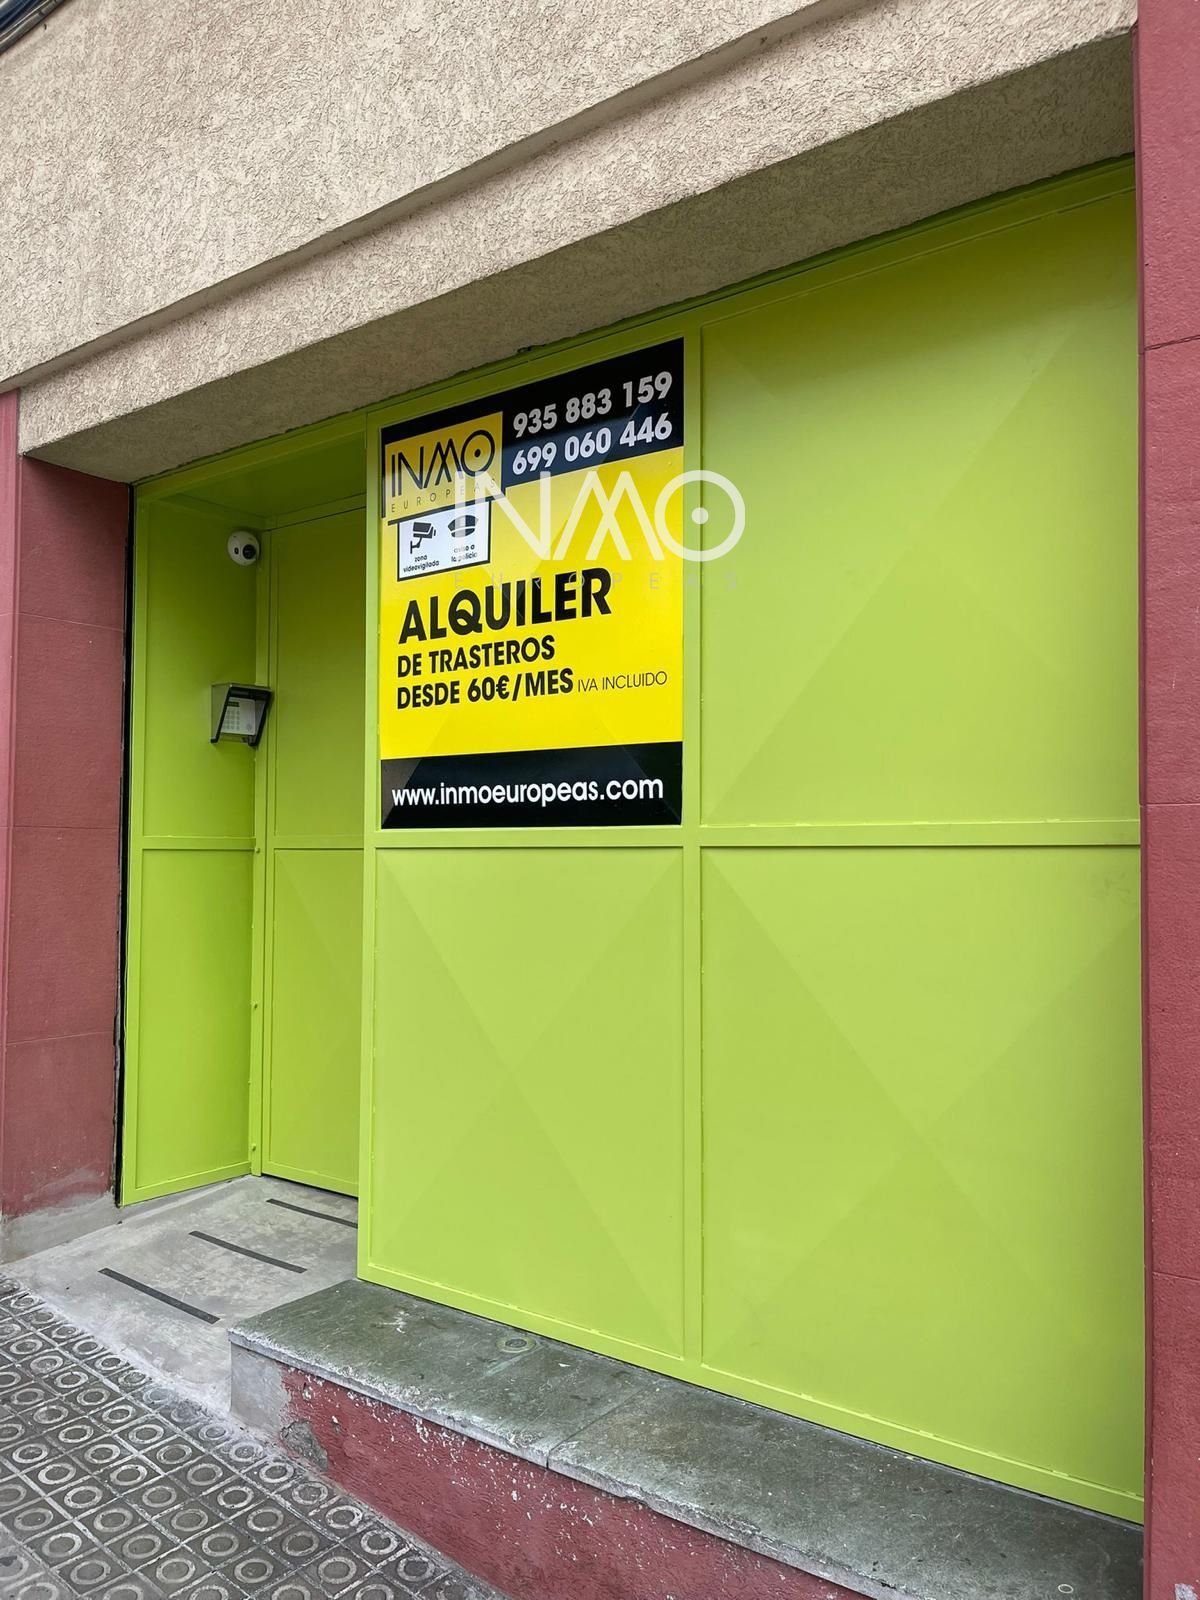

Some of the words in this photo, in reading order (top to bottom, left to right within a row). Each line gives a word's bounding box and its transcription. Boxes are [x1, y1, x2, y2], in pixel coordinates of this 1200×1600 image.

[513, 407, 558, 438] 935
[566, 388, 612, 424] 883
[622, 371, 673, 408] 159
[391, 429, 496, 498] INMO
[512, 442, 557, 475] 699
[564, 427, 612, 462] 060
[620, 412, 673, 448] 446
[403, 560, 440, 573] videovigilada
[414, 554, 428, 563] zona
[398, 567, 612, 645] ALQUILER
[397, 652, 422, 678] DE
[429, 634, 556, 675] TRASTEROS
[397, 682, 460, 710] DESDE
[467, 668, 574, 702] 60€/MES
[578, 677, 599, 692] IVA
[602, 670, 668, 690] INCLUIDO
[391, 776, 664, 807] www.inmoeuropeas.com
